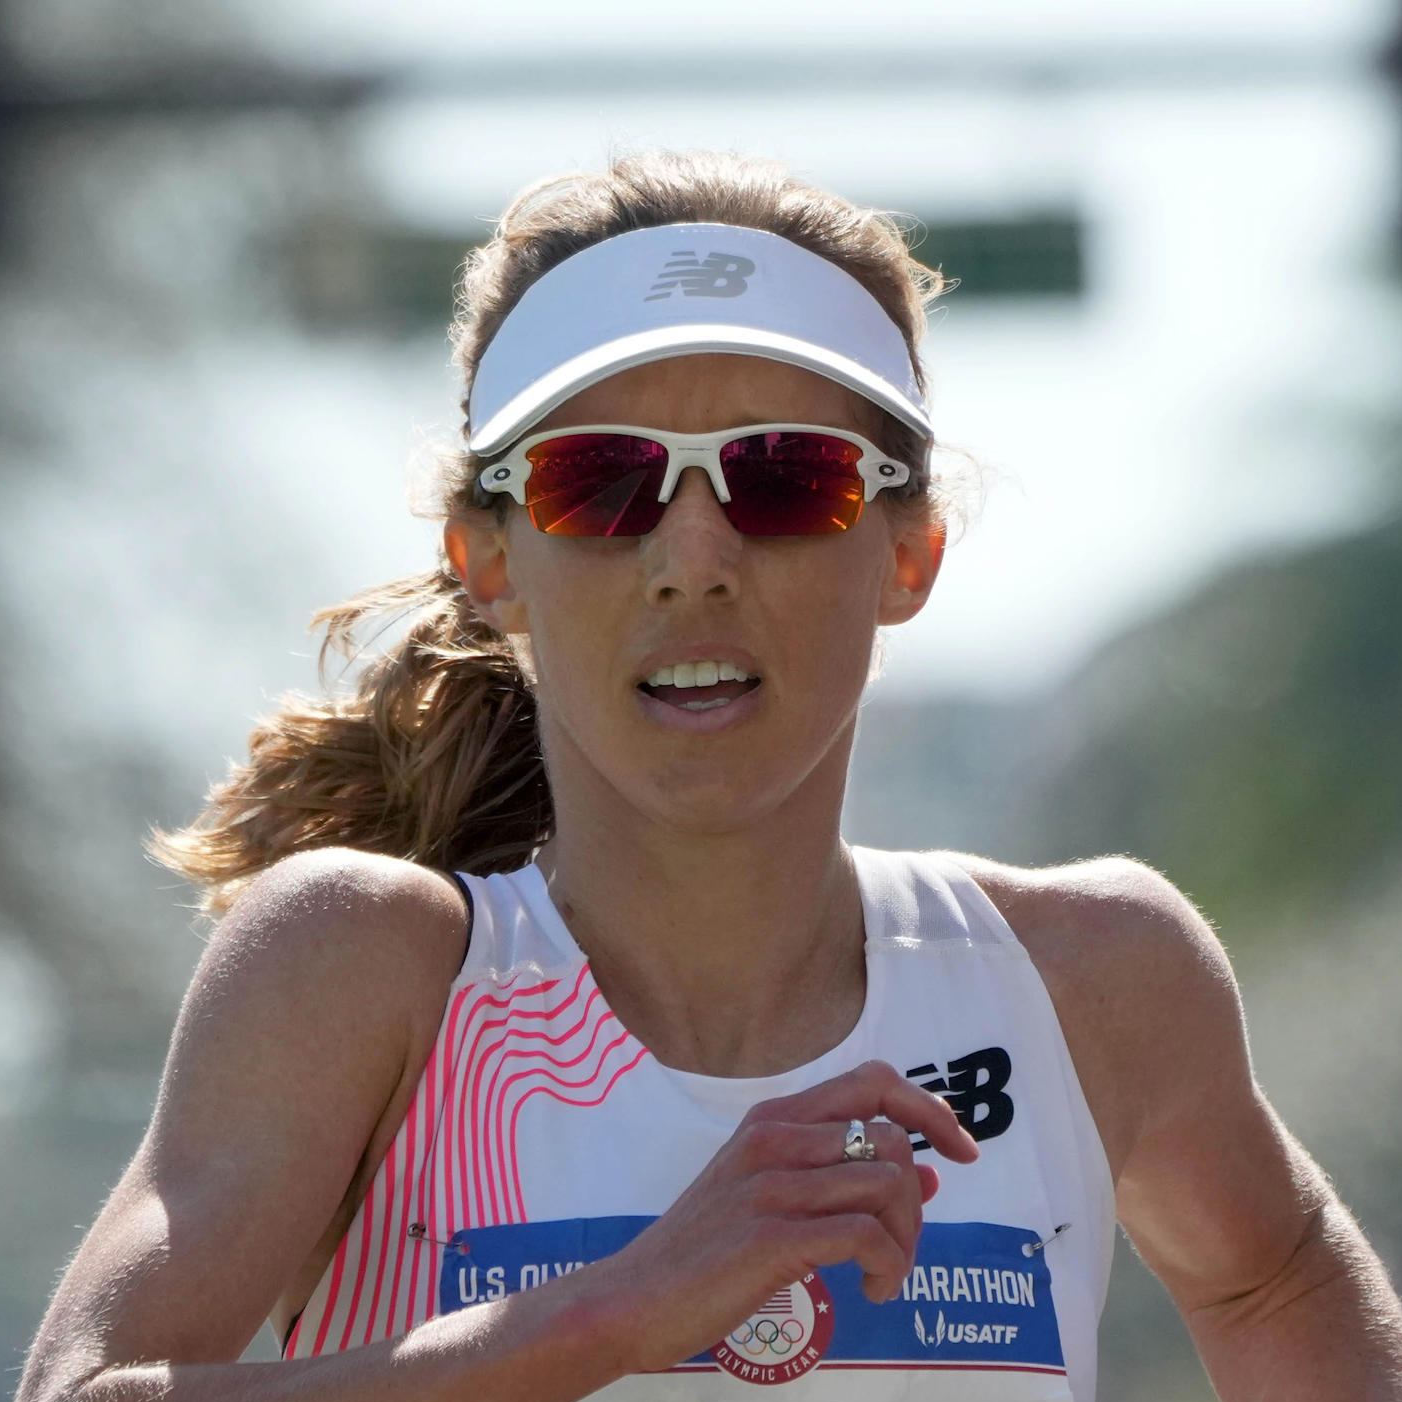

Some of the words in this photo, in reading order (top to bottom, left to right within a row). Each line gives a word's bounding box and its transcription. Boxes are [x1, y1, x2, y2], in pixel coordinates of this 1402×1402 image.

[643, 250, 756, 302] NB
[905, 1046, 1014, 1152] B
[948, 1323, 1018, 1345] USATF
[716, 1347, 775, 1381] OLYMPIC
[784, 1346, 820, 1378] TEAM
